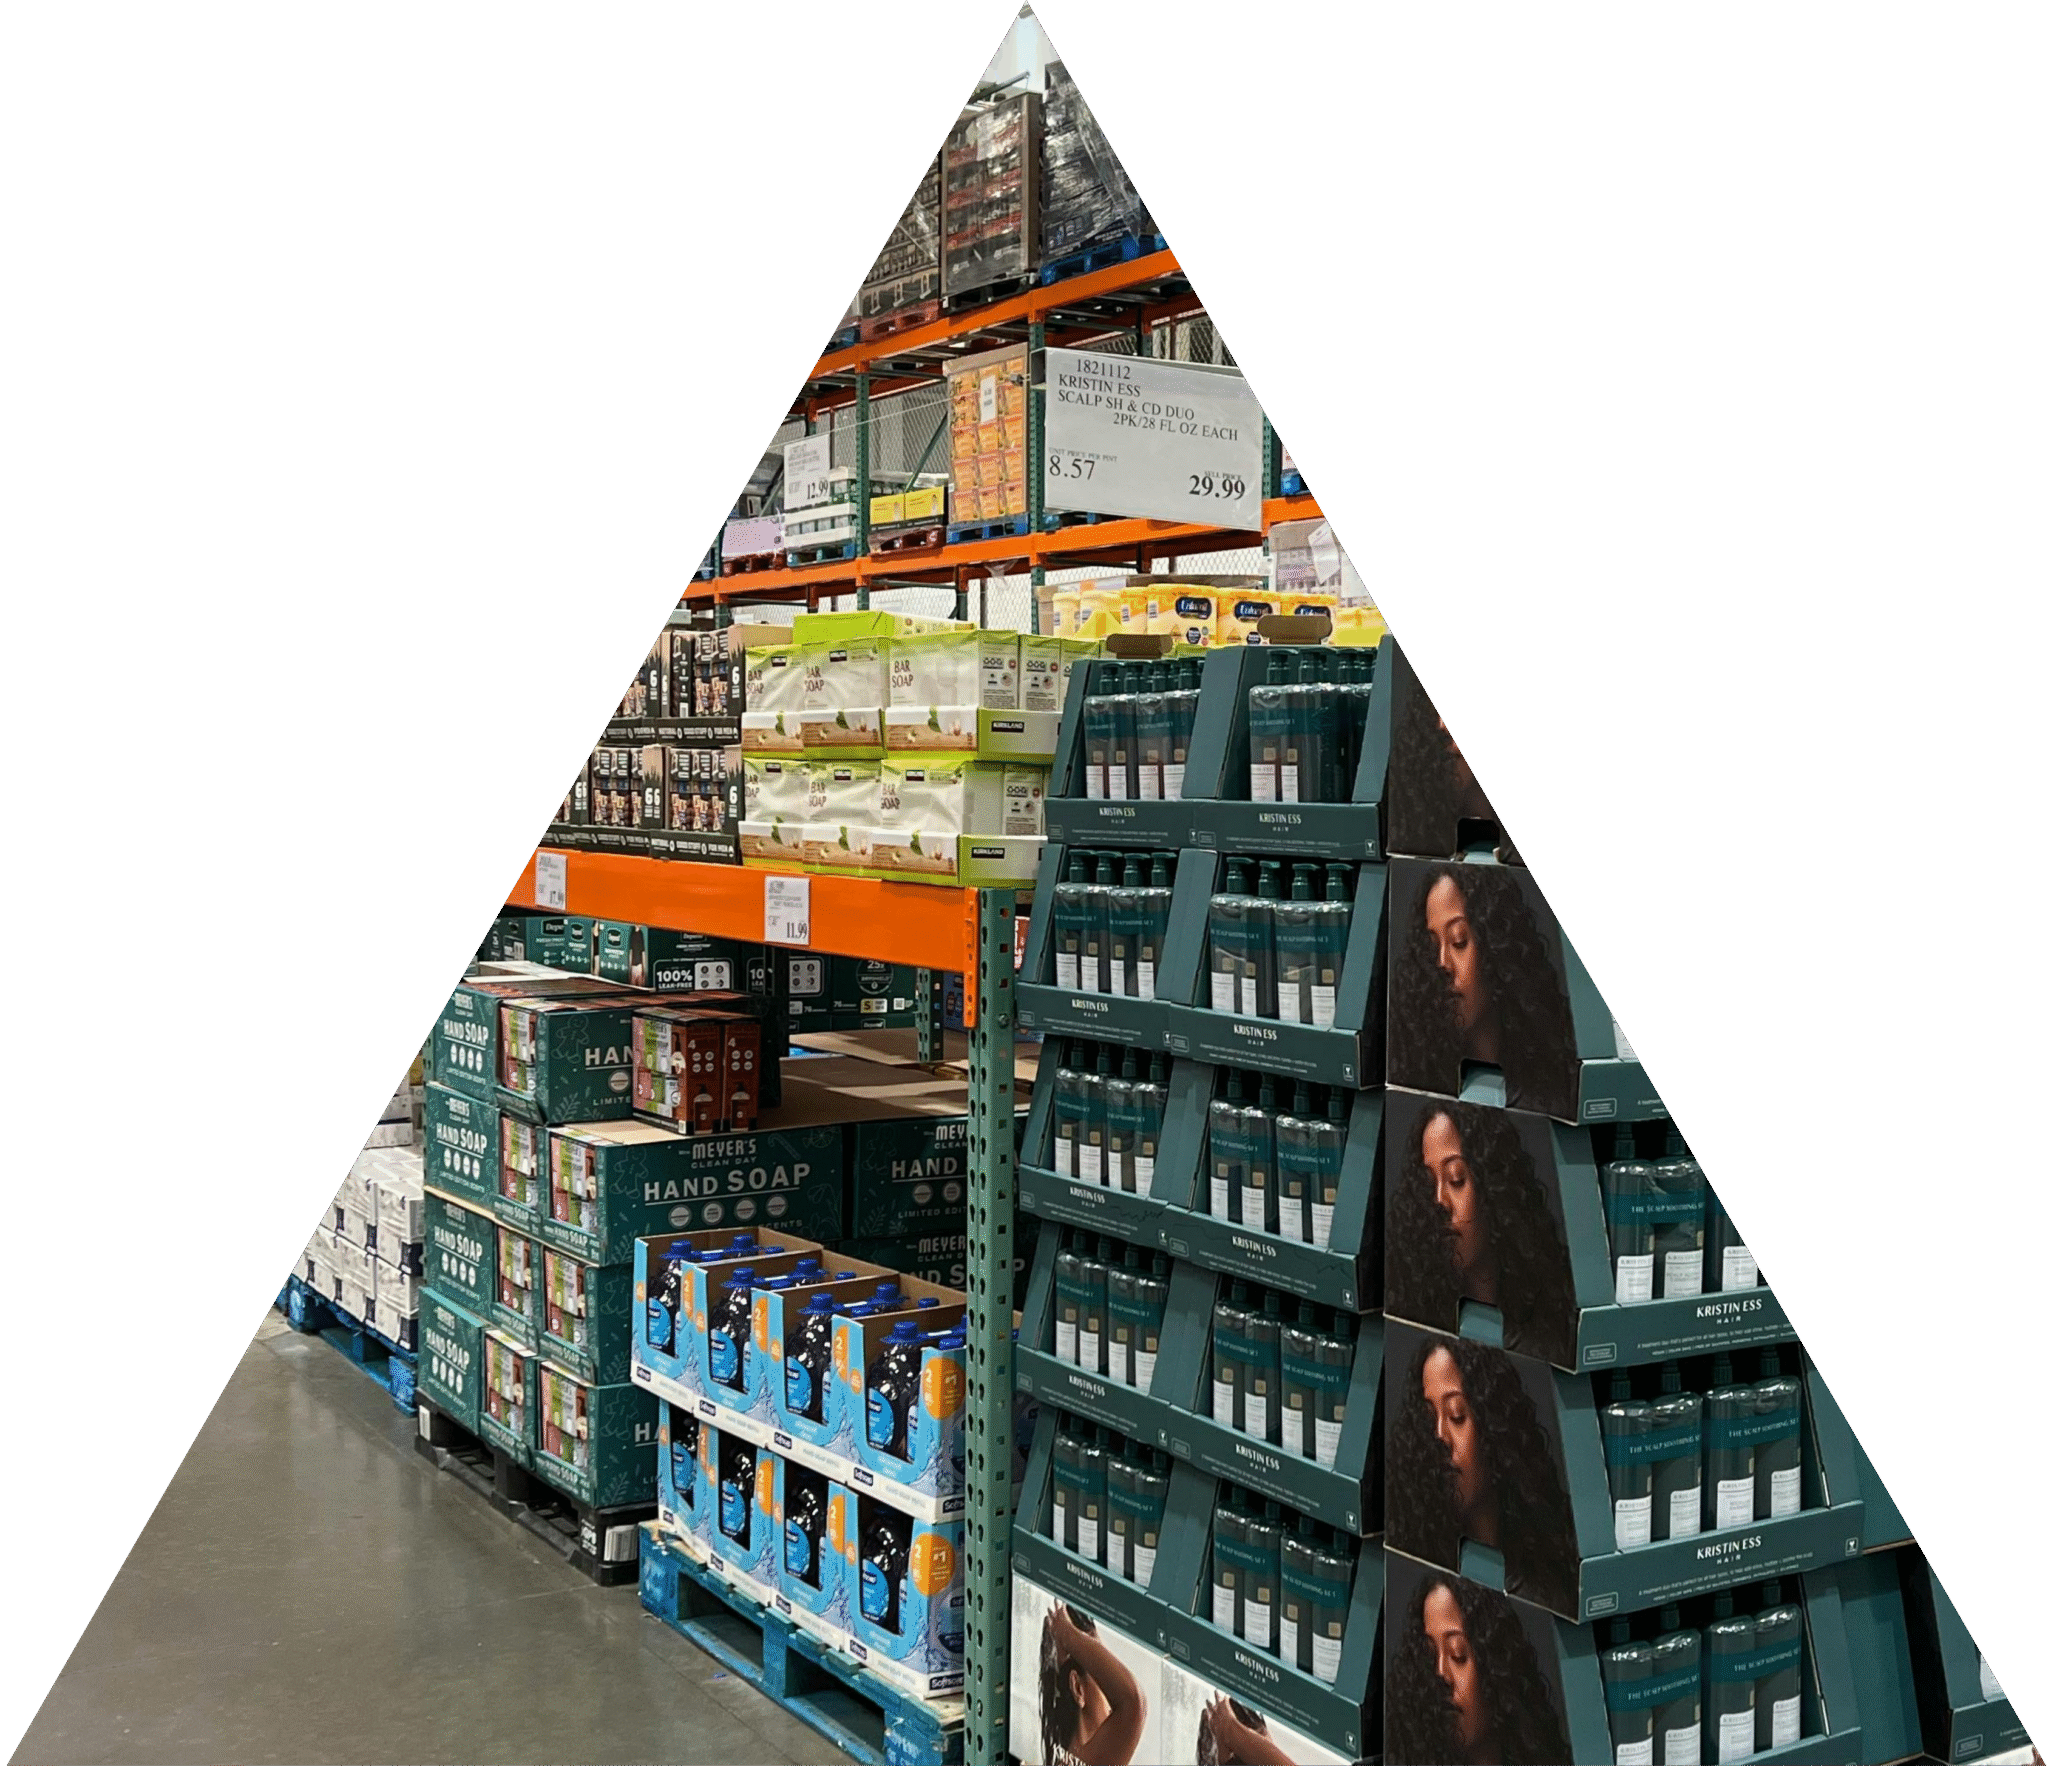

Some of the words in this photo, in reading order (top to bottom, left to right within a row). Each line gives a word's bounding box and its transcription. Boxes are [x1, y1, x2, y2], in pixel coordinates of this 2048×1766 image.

[1077, 359, 1131, 380] 1821112
[1059, 374, 1113, 393] KRISTIN
[1118, 383, 1141, 398] ESS
[1058, 390, 1102, 407] SCALP
[1106, 398, 1123, 411] SH
[1128, 402, 1138, 413] &
[1142, 403, 1161, 416] CD
[1166, 406, 1195, 421] DUO
[1113, 413, 1156, 429] 2PK/28
[1160, 420, 1176, 433] FL
[1180, 422, 1198, 436] OZ
[1202, 425, 1238, 441] EACH
[1067, 449, 1086, 458] PRICE
[1049, 455, 1095, 481] 8.57
[1222, 473, 1242, 481] PRICE
[1189, 475, 1246, 500] 29.99
[732, 666, 740, 684] 6
[892, 675, 914, 688] SOAP
[746, 682, 764, 694] SOAP
[804, 680, 824, 692] SOAP
[645, 788, 653, 805] 6
[729, 786, 738, 804] 6
[1099, 807, 1124, 817] KRISTIN
[1124, 808, 1136, 817] ESS
[1259, 813, 1287, 824] KRISTIN
[1288, 814, 1302, 824] ESS
[787, 922, 808, 939] 11.99
[657, 969, 693, 983] 100%
[1072, 999, 1096, 1011] KRISTIN
[1097, 1002, 1109, 1012] ESS
[443, 1019, 465, 1040] HAND
[465, 1022, 489, 1046] SOAP
[1234, 1024, 1262, 1038] KRISTIN
[1263, 1029, 1278, 1041] ESS
[688, 1040, 696, 1050] 4
[728, 1038, 736, 1048] 4
[585, 1046, 633, 1066] HAN
[436, 1123, 459, 1145] HAND
[460, 1128, 488, 1155] SOAP
[692, 1138, 757, 1160] MEYER'S
[691, 1160, 730, 1169] CLEAN
[735, 1156, 757, 1166] DAY
[891, 1157, 958, 1179] HAND
[644, 1176, 719, 1201] HAND
[727, 1163, 811, 1192] SOAP
[1070, 1186, 1094, 1201] KRISTIN
[1094, 1193, 1105, 1204] ESS
[898, 1208, 941, 1220] LIMITED
[434, 1226, 456, 1250] HAND
[456, 1233, 483, 1262] SOAP
[1232, 1236, 1262, 1253] KRISTIN
[1262, 1244, 1277, 1257] ESS
[918, 1252, 952, 1263] CLEAN
[1696, 1302, 1740, 1318] KRISTIN
[1743, 1298, 1762, 1312] ESS
[1716, 1316, 1742, 1325] HAIR
[426, 1328, 446, 1354] HAND
[446, 1338, 470, 1370] SOAP
[835, 1336, 842, 1350] 2
[925, 1368, 932, 1383] 2
[1069, 1374, 1094, 1391] KRISTIN
[1093, 1384, 1105, 1396] ESS
[1729, 1430, 1742, 1438] THE
[1743, 1426, 1761, 1436] SCALP
[1629, 1446, 1643, 1454] THE
[1644, 1443, 1663, 1452] SCALP
[1236, 1444, 1265, 1463] KRISTIN
[1265, 1456, 1280, 1471] ESS
[758, 1468, 764, 1481] 2
[830, 1504, 837, 1520] 2
[915, 1544, 922, 1558] 2
[1696, 1540, 1740, 1560] KRISTIN
[1742, 1535, 1762, 1550] ESS
[1717, 1554, 1741, 1565] HAIR
[1067, 1562, 1092, 1582] KRISTIN
[1091, 1574, 1103, 1589] ESS
[1235, 1651, 1264, 1673] KRISTIN
[1264, 1666, 1279, 1683] ESS
[1734, 1664, 1747, 1672] THE
[1628, 1692, 1641, 1700] THE
